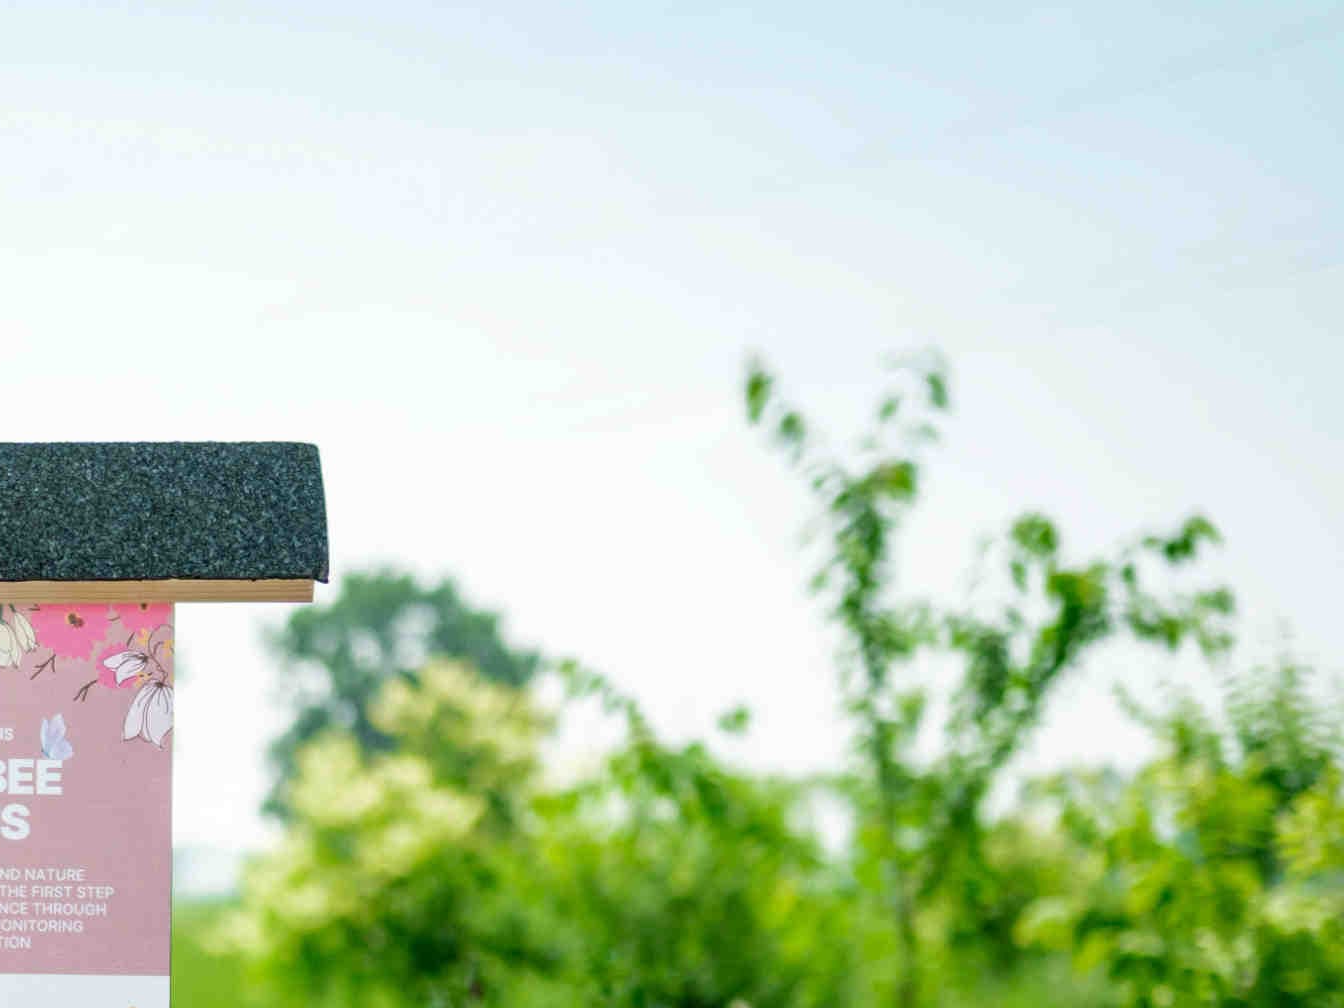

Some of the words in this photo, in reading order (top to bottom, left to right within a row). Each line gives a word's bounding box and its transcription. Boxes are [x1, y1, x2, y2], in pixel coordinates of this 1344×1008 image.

[24, 868, 86, 882] NATURE
[0, 884, 27, 898] THE
[31, 885, 73, 898] FIRST
[77, 886, 115, 899] STEP
[34, 902, 106, 916] THROUGH
